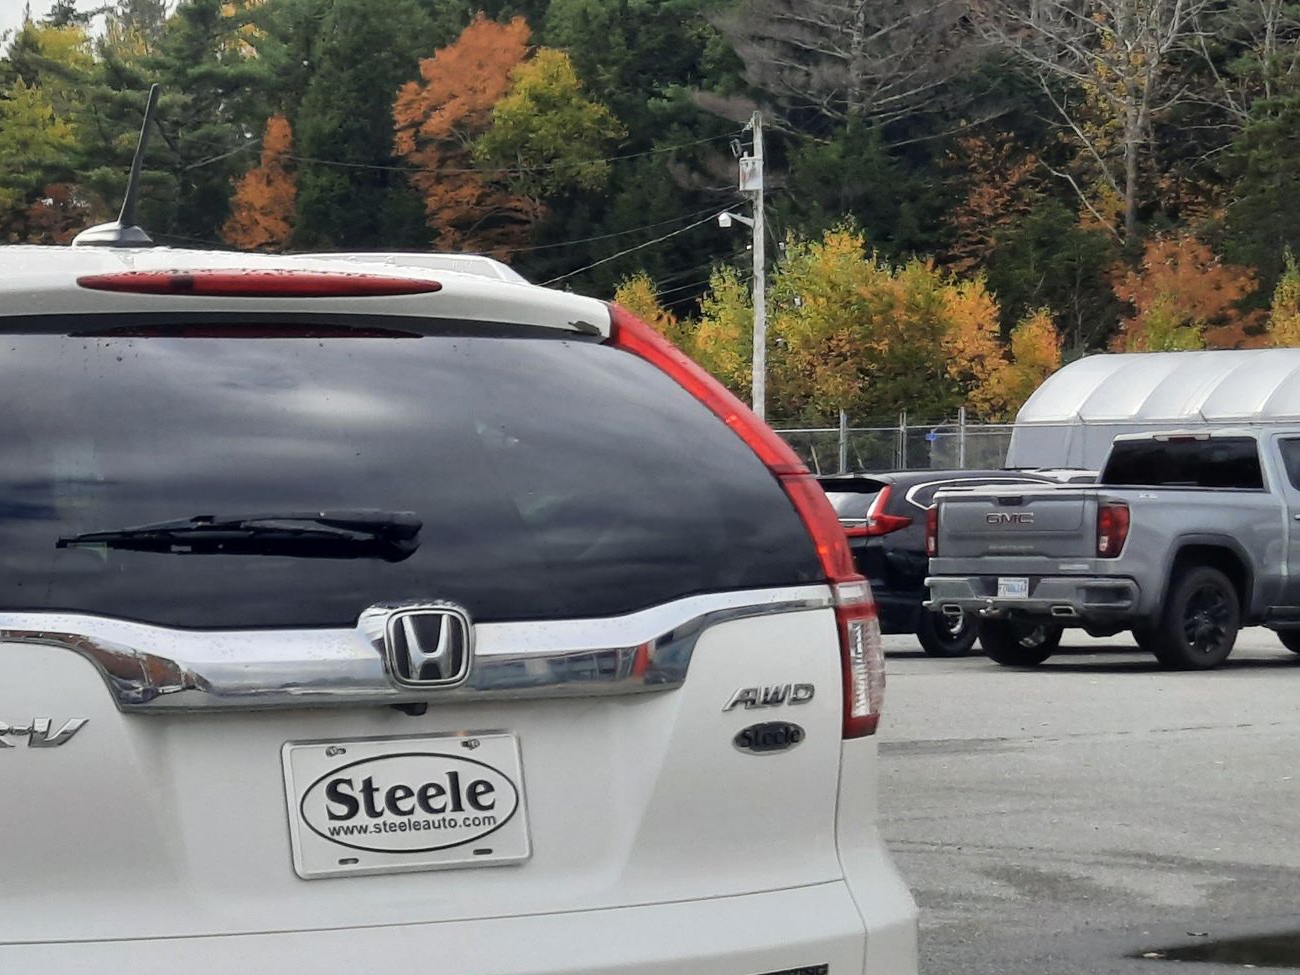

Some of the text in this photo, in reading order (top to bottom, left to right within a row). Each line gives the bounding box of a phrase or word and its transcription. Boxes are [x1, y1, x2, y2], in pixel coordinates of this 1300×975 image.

[986, 511, 1035, 524] GMC
[721, 683, 815, 712] AWD
[735, 725, 802, 748] Steele
[325, 771, 496, 821] Steele
[327, 815, 497, 836] www.steeleauto.com
